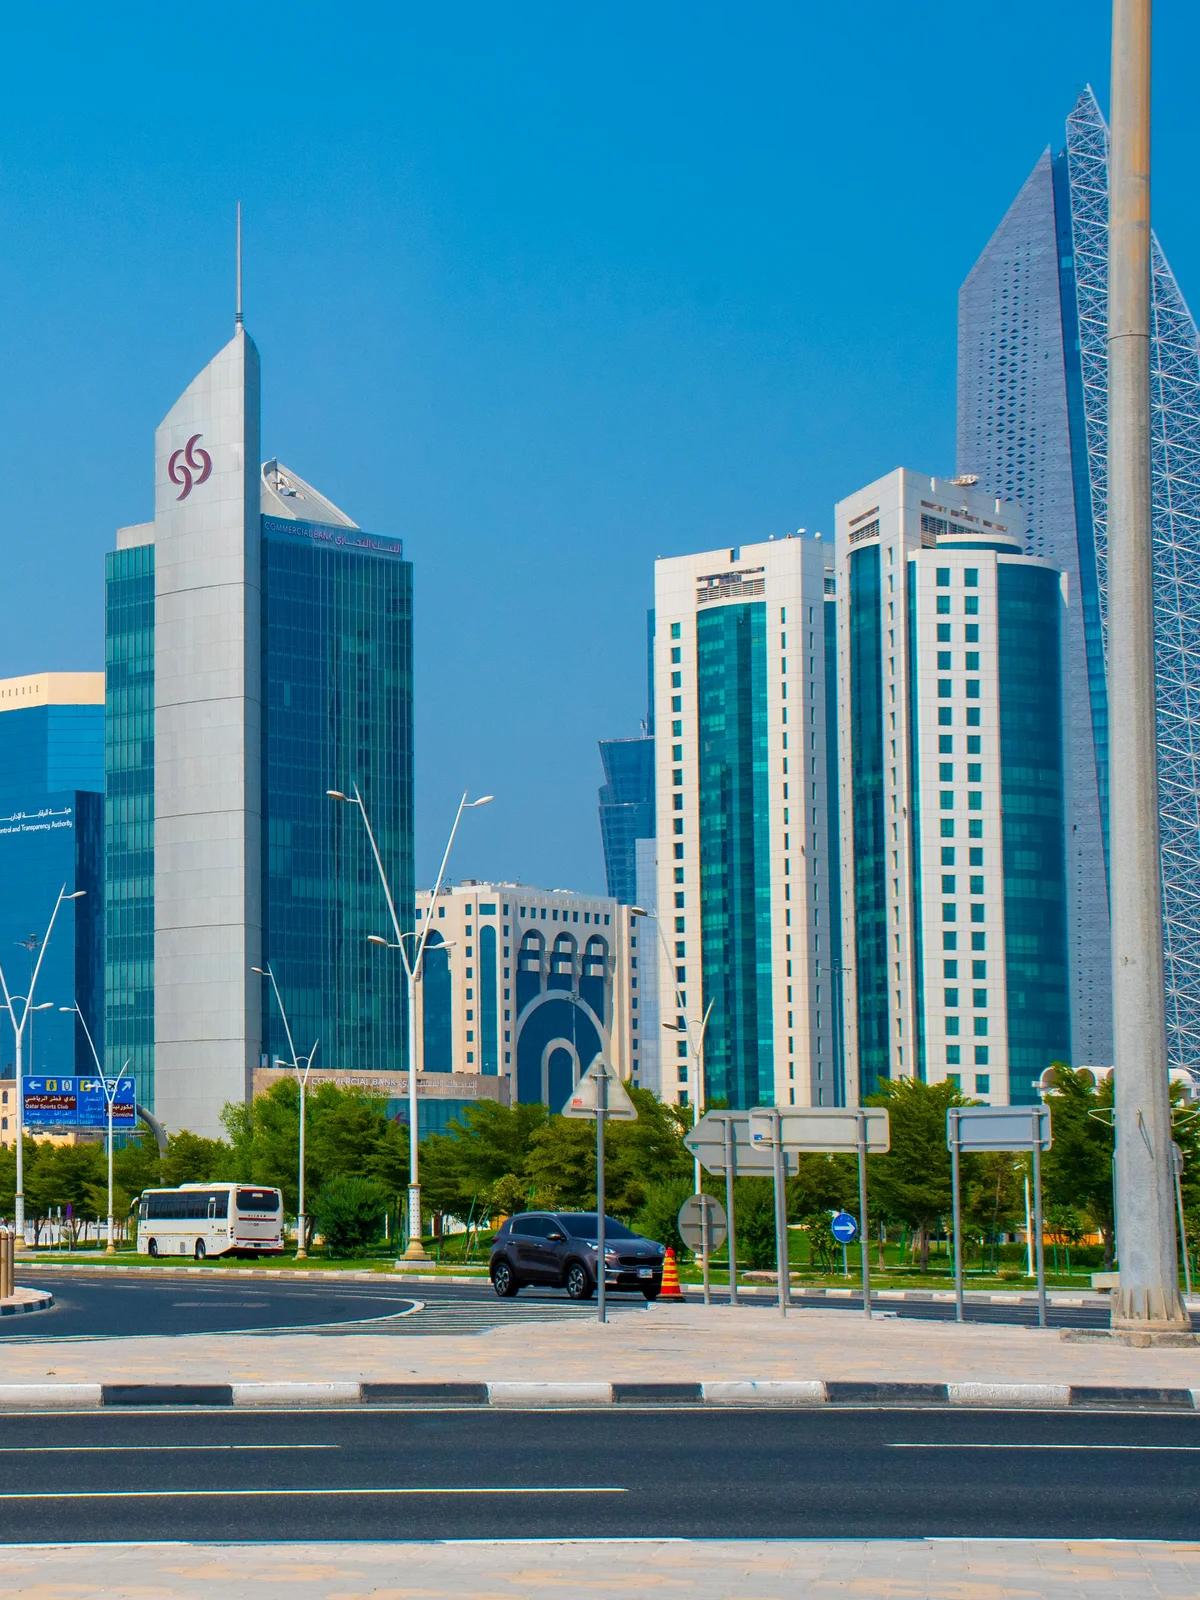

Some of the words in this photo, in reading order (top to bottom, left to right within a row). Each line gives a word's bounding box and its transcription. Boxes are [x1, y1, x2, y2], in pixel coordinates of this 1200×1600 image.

[12, 824, 20, 832] and
[21, 822, 51, 831] Transparency
[51, 819, 73, 828] Authority
[372, 1078, 397, 1086] BANK
